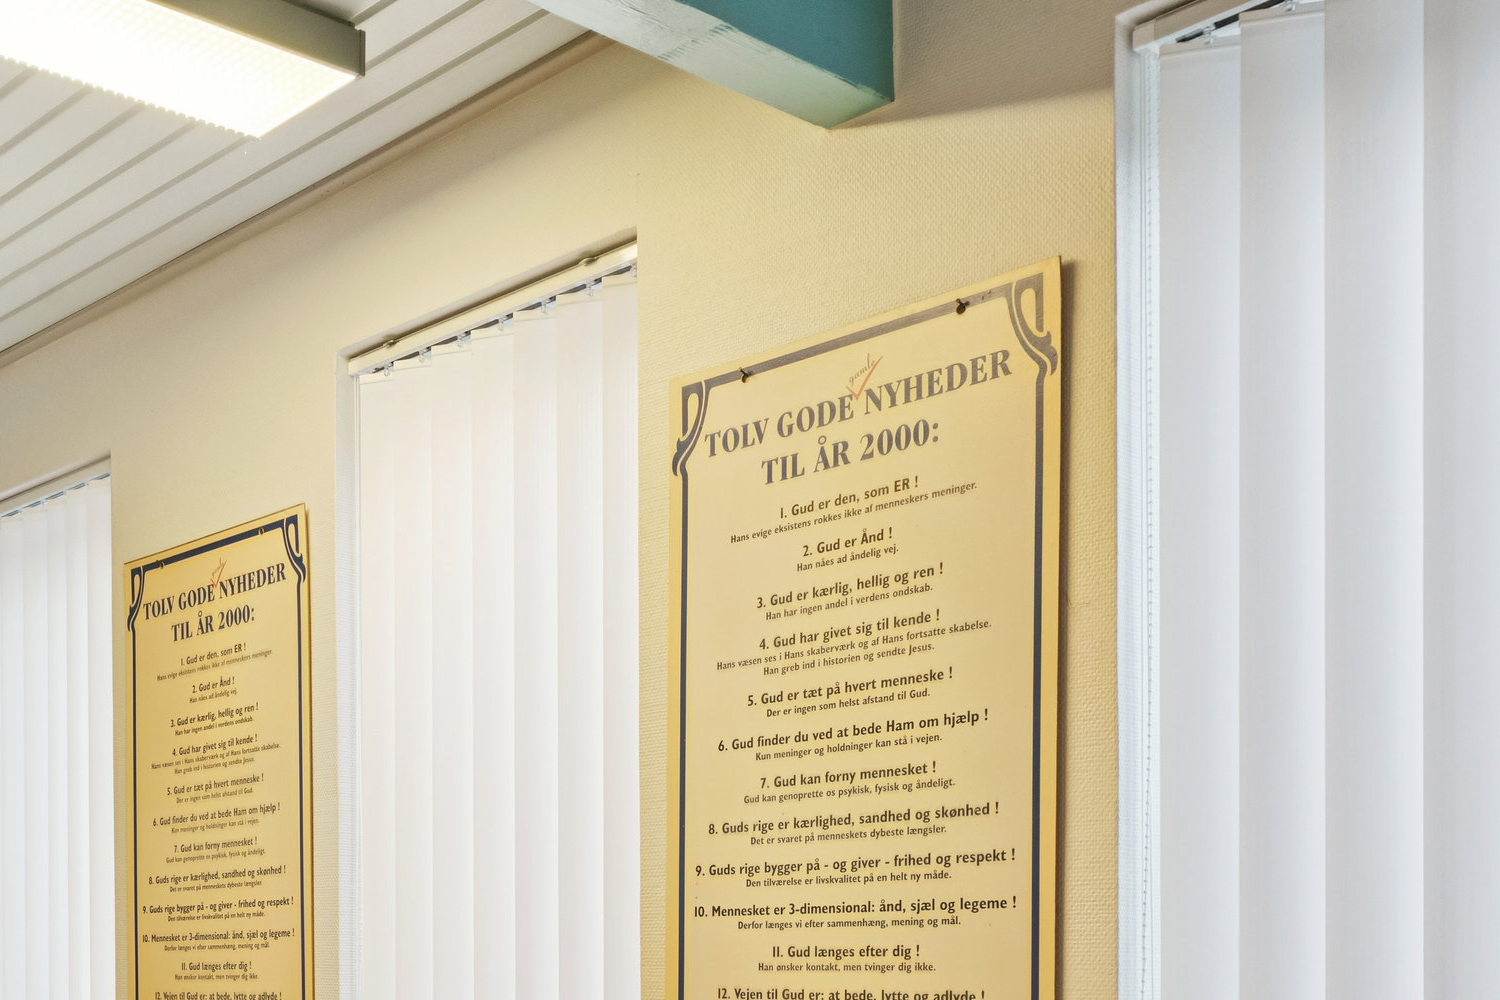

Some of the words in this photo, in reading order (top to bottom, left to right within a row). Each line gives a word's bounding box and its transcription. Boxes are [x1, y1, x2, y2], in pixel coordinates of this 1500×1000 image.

[703, 417, 770, 458] TOLV
[776, 392, 855, 438] GODE
[863, 349, 1013, 416] NYHEDER
[760, 452, 805, 485] TIL
[813, 434, 851, 473] ÅR
[859, 419, 939, 462] 2000:
[791, 499, 815, 517] Gud
[818, 499, 831, 511] er
[834, 493, 860, 507] den,
[864, 485, 890, 500] som
[893, 477, 910, 493] ER
[730, 533, 750, 544] Hans
[751, 528, 773, 539] evige
[774, 519, 812, 534] eksistens
[813, 512, 842, 526] rokkes
[844, 507, 863, 519] ikke
[864, 503, 874, 514] af
[875, 493, 929, 512] menneskers
[796, 562, 813, 572] Han
[836, 553, 848, 564] ad
[849, 547, 882, 562] åndelig
[816, 537, 841, 554] Gud
[844, 537, 858, 549] er
[860, 527, 885, 545] Ånd
[142, 595, 175, 621] TOLV
[178, 582, 215, 611] GODE
[218, 562, 287, 599] NYHEDER
[770, 590, 793, 606] Gud
[796, 591, 809, 602] er
[812, 581, 853, 599] kærlig,
[856, 573, 890, 591] hellig
[893, 571, 909, 585] og
[913, 567, 935, 580] ren
[171, 620, 193, 642] TIL
[196, 610, 215, 636] ÅR
[218, 604, 255, 628] 2000:
[765, 611, 782, 621] Han
[783, 608, 798, 618] har
[799, 604, 823, 615] ingen
[824, 597, 848, 610] andel
[855, 592, 890, 605] verdens
[760, 690, 784, 705] Gud
[787, 691, 800, 702] er
[802, 687, 823, 699] tæt
[826, 681, 841, 699] på
[844, 679, 877, 694] hvert
[880, 668, 944, 689] menneske
[758, 962, 774, 972] Han
[776, 962, 804, 972] ønsker
[843, 964, 862, 972] men
[864, 962, 896, 974] tvinger
[897, 961, 912, 974] dig
[787, 945, 811, 958] Gud
[814, 945, 855, 960] længes
[858, 944, 889, 958] efter
[892, 944, 912, 961] dig
